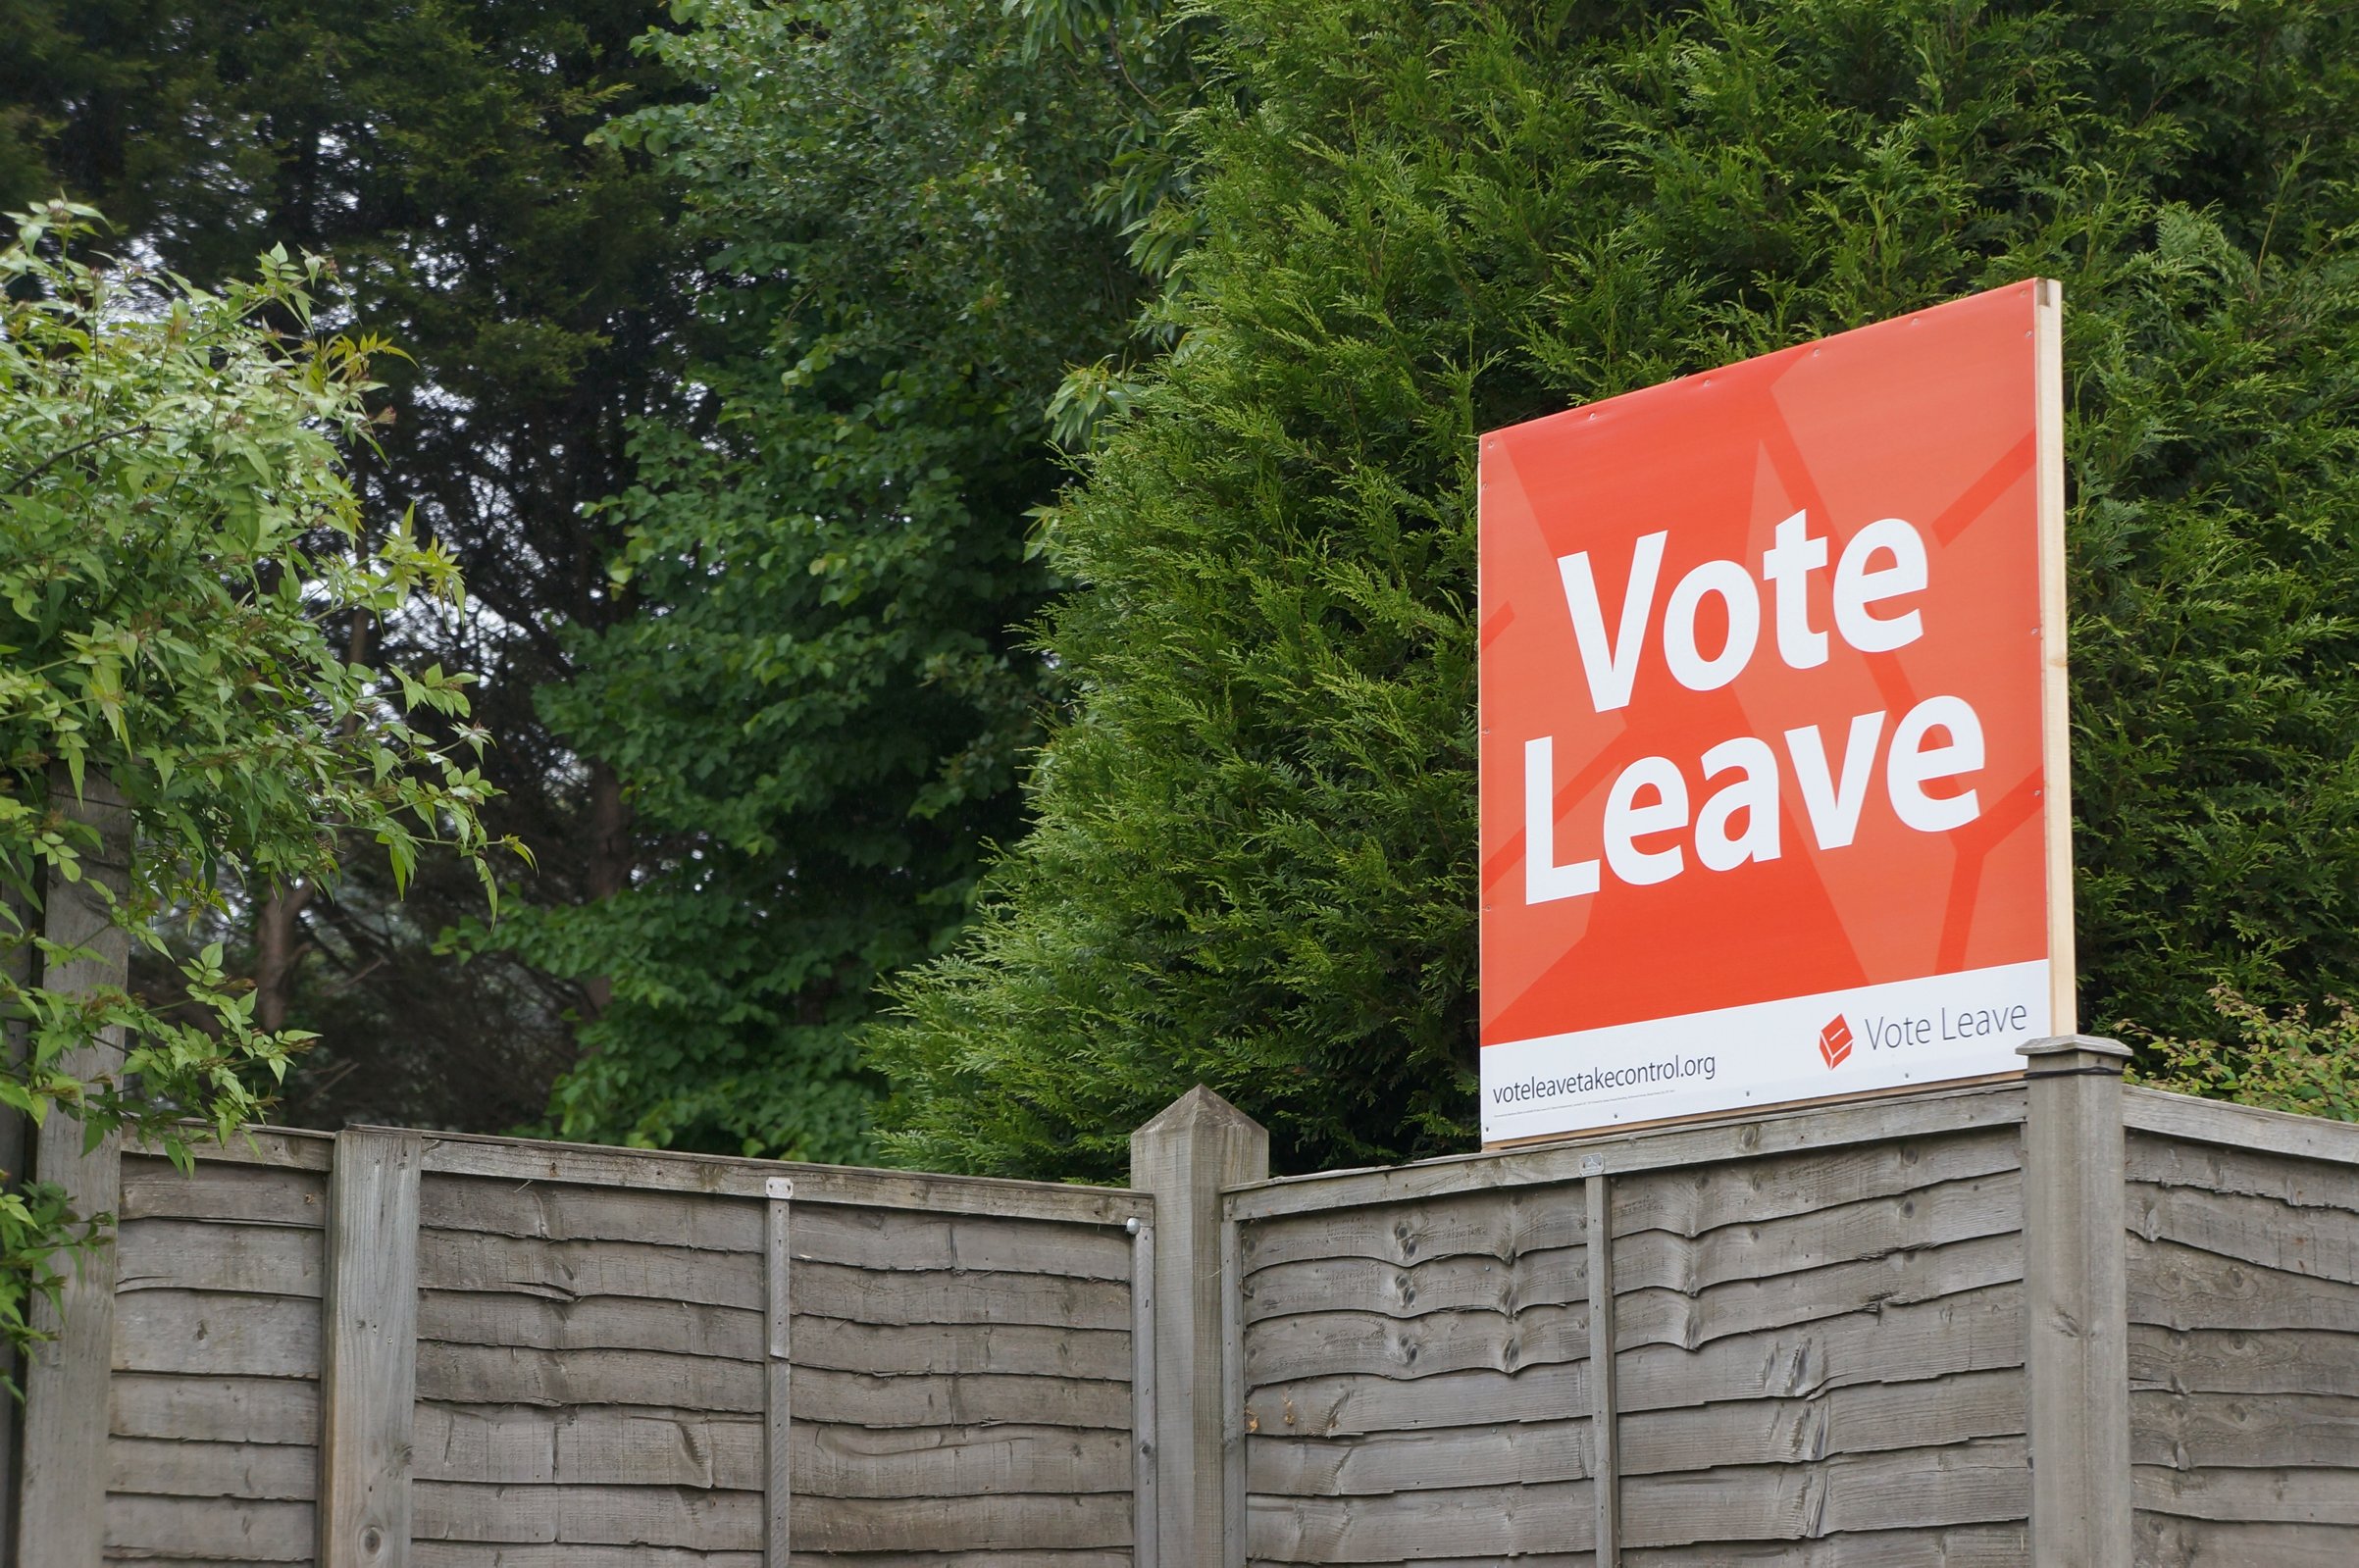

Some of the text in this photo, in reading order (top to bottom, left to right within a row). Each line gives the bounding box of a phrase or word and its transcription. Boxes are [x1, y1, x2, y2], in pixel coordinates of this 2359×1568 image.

[1557, 508, 1928, 714] Vote
[1524, 694, 1986, 905] Leave
[1492, 1054, 1716, 1104] voteleavetakecontrol.org
[1865, 1003, 2027, 1051] Vote Leave
